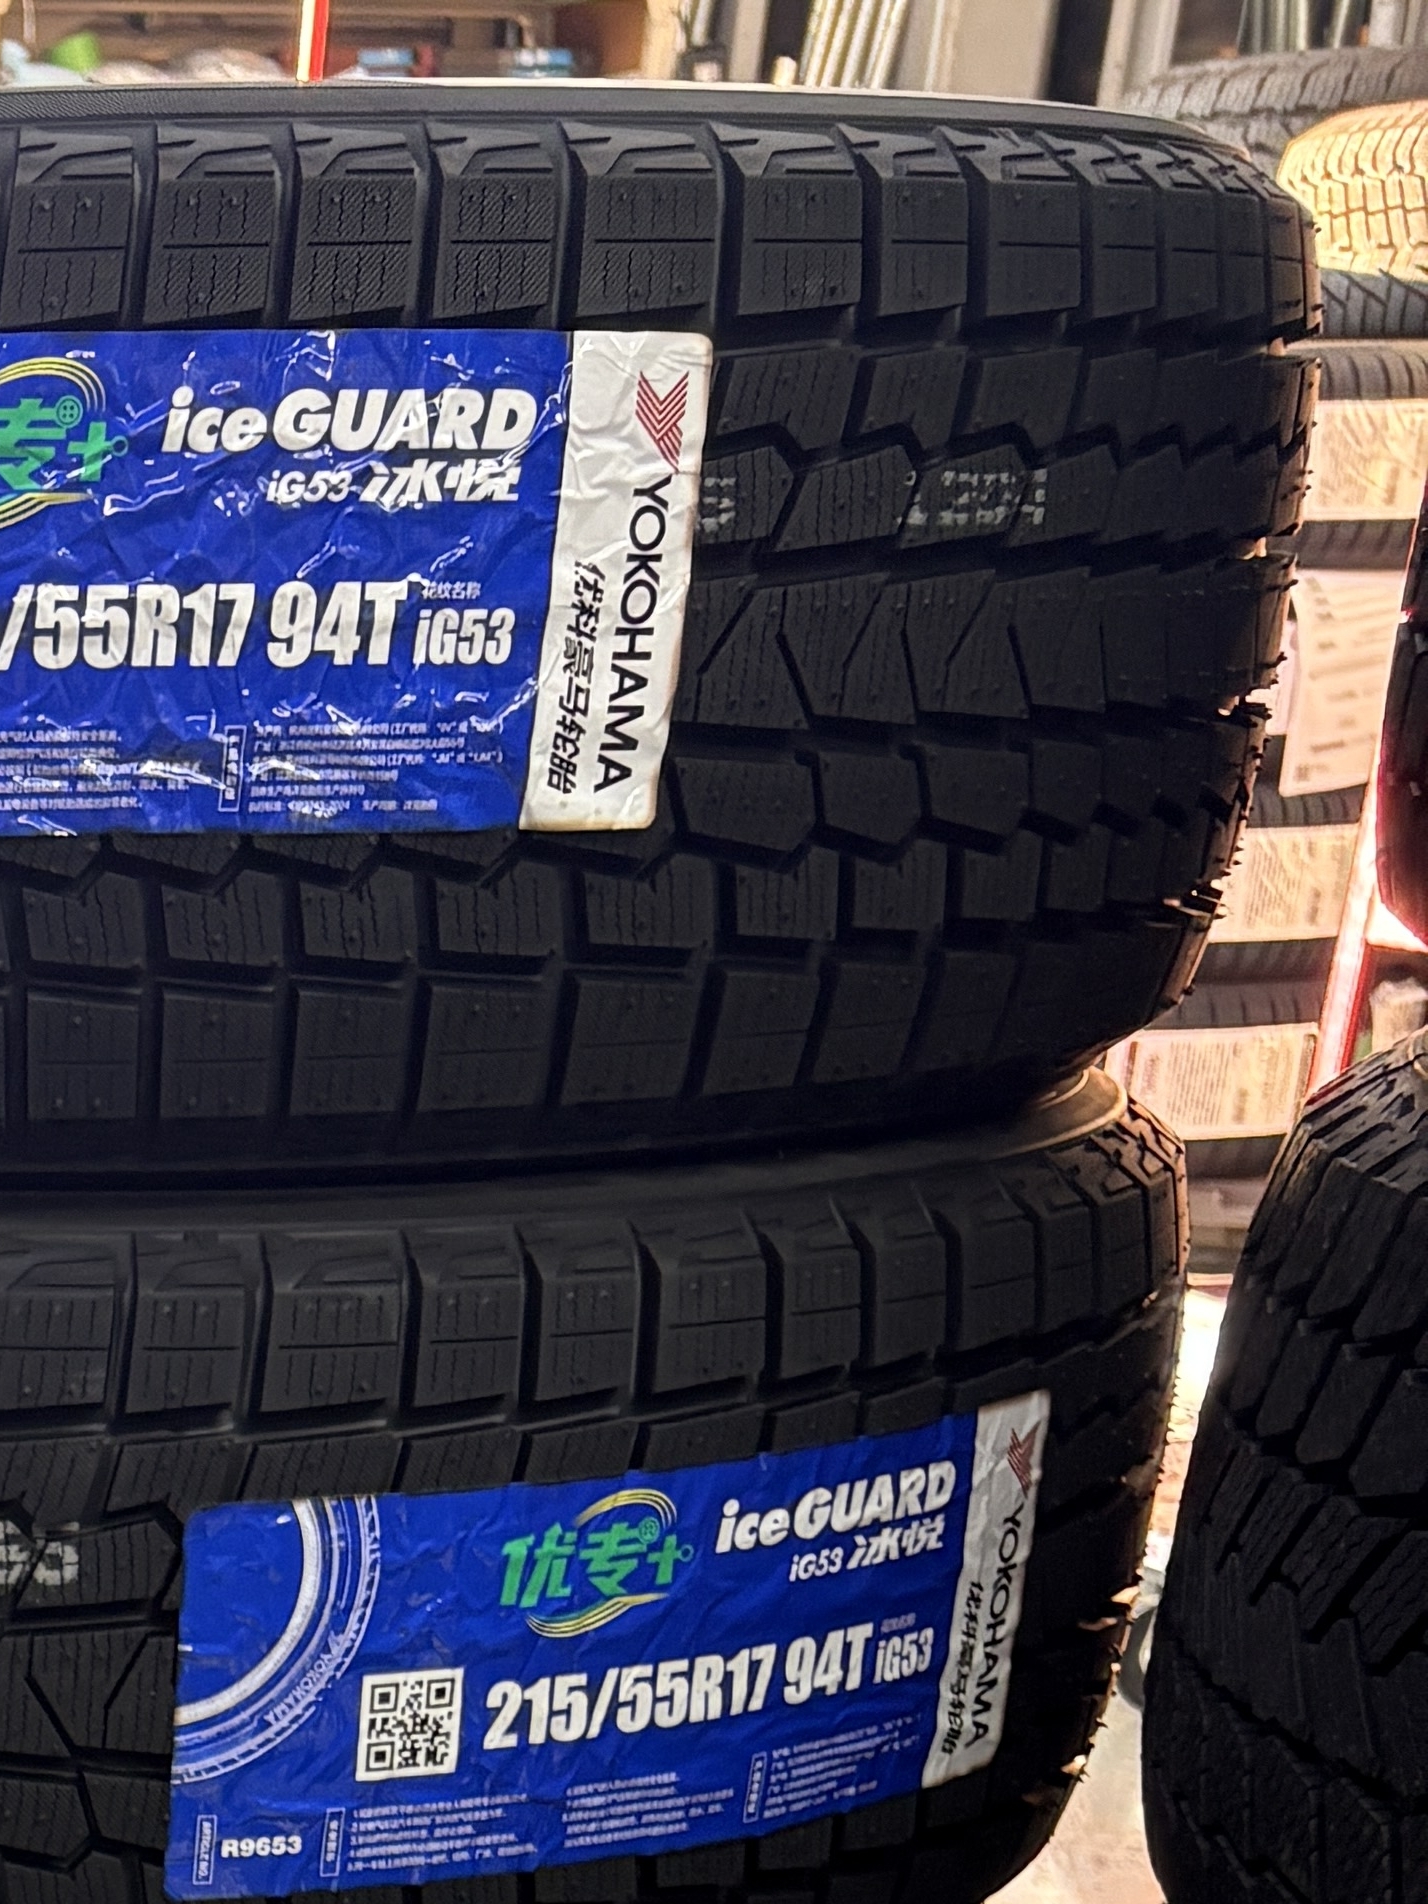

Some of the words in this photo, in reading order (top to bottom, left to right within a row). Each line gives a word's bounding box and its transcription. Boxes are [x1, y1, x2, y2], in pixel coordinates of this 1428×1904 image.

[266, 469, 350, 503] iG53
[267, 577, 409, 668] 94T
[412, 607, 517, 664] iG53
[594, 473, 673, 793] YOKOHAMA
[546, 560, 607, 795] 优科豪马轮胎
[789, 1549, 843, 1583] iG53
[873, 1626, 936, 1685] iG53
[965, 1502, 1025, 1746] YOKOHAMA
[482, 1654, 773, 1751] 215/55R17
[780, 1619, 874, 1710] 94T
[220, 1834, 304, 1860] R9653
